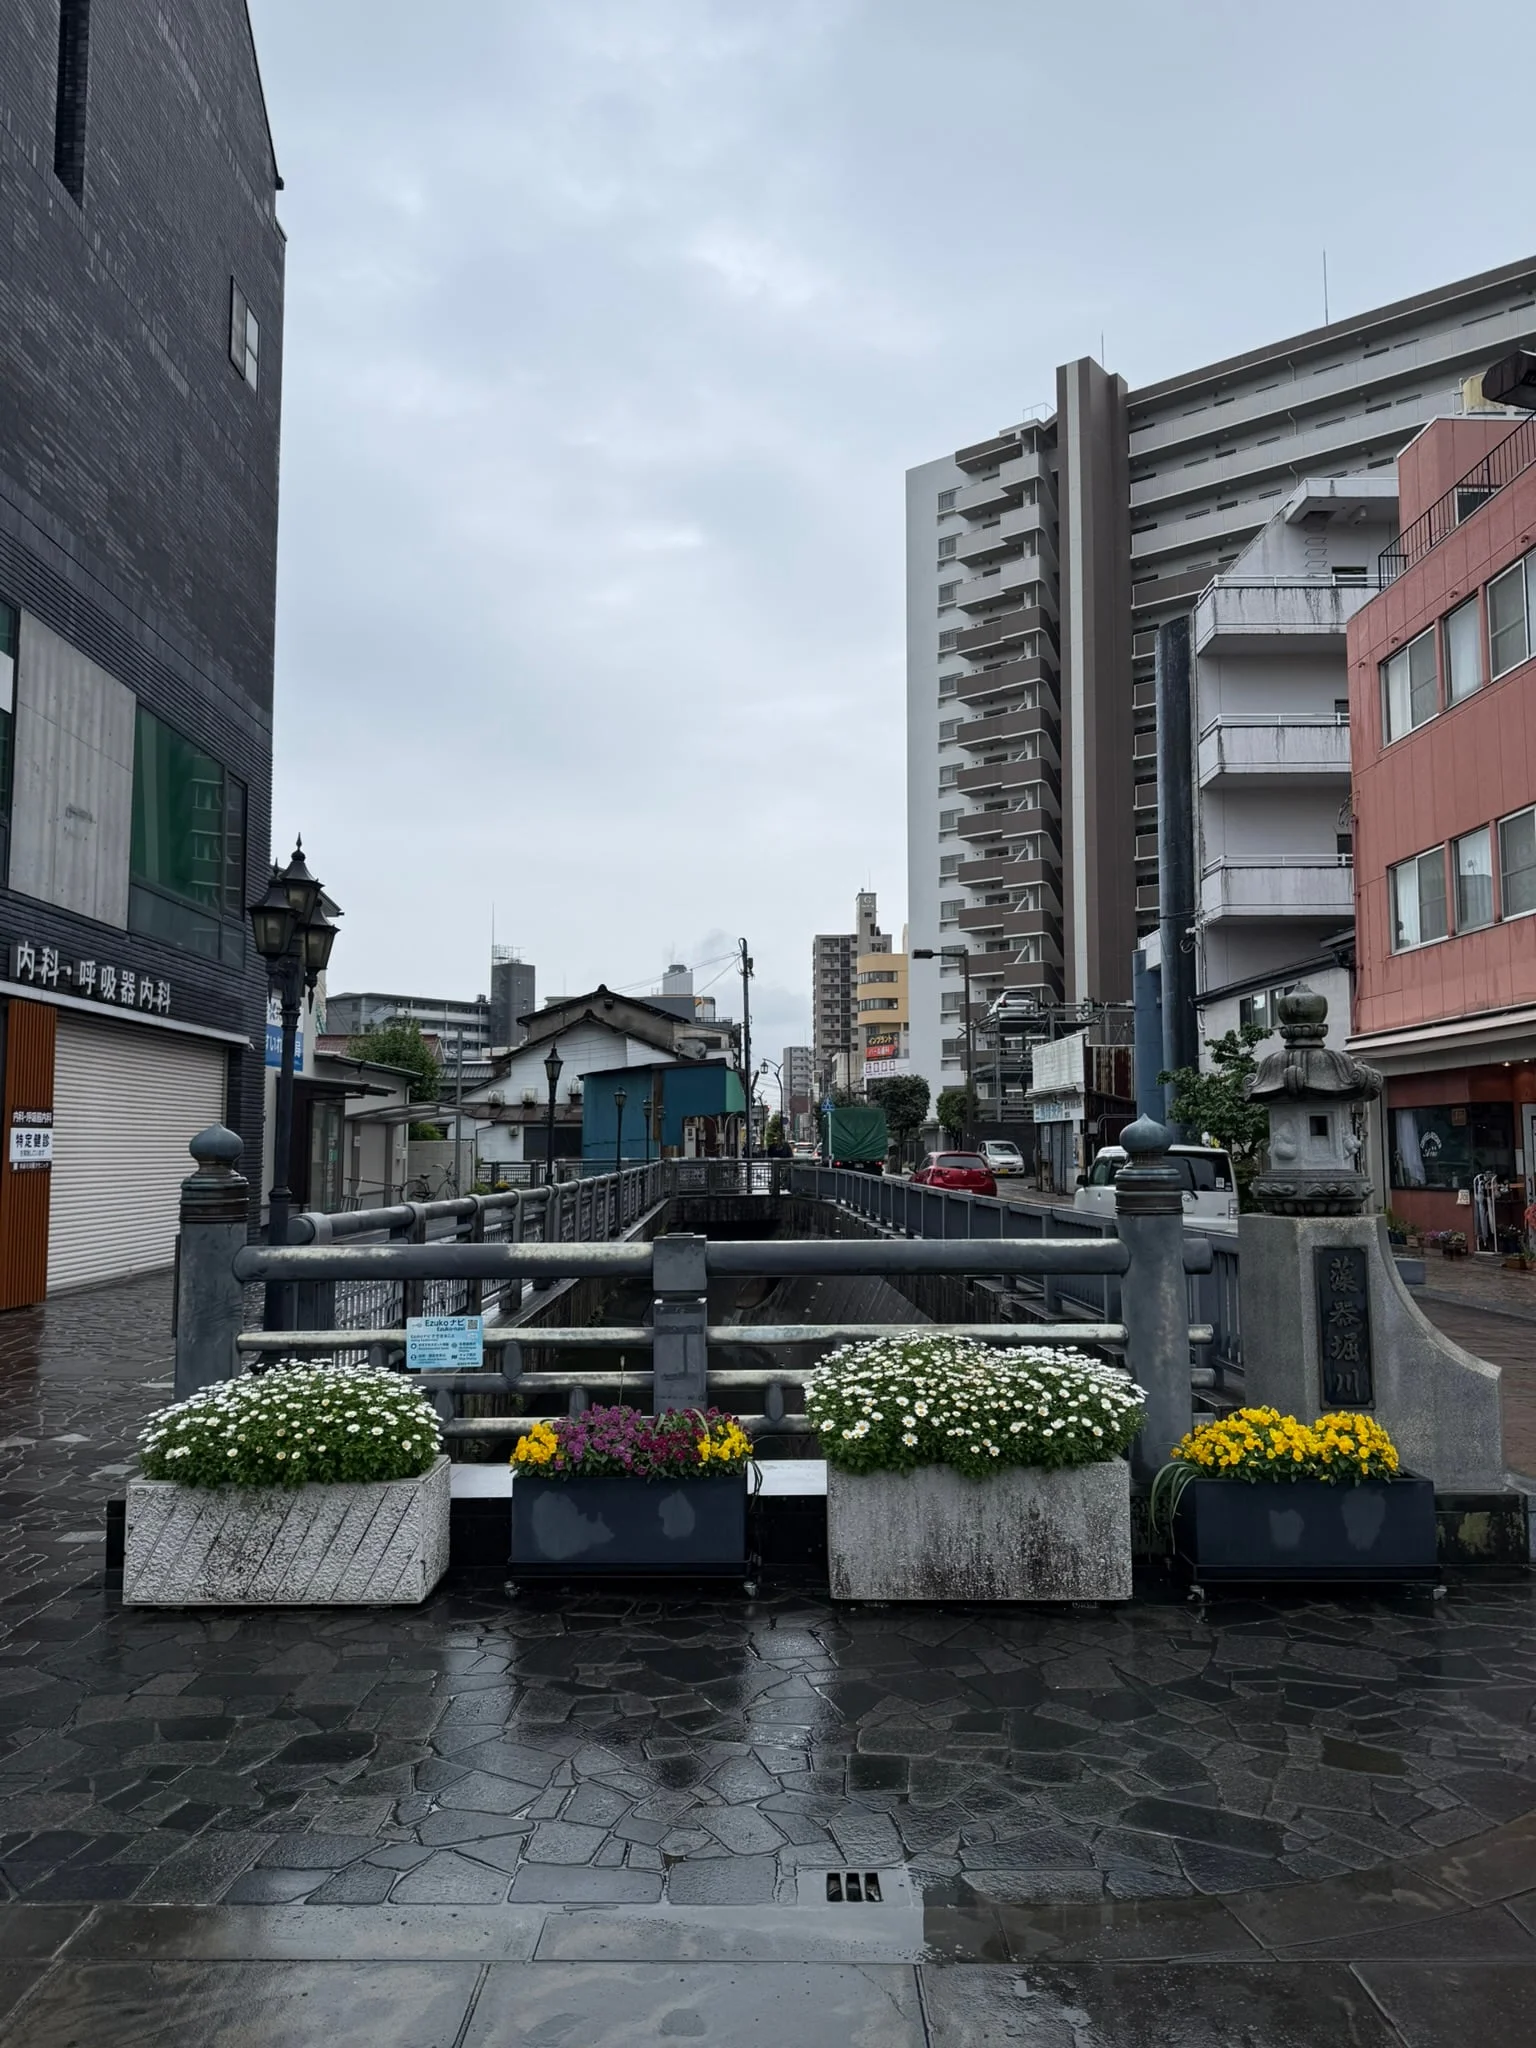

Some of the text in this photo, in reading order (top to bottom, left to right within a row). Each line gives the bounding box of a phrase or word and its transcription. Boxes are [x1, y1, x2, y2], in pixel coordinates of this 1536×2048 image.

[16, 940, 171, 1014] 内科・呼吸器内科
[15, 1133, 50, 1148] 特定健診
[425, 1318, 465, 1327] Ezuko ナビ
